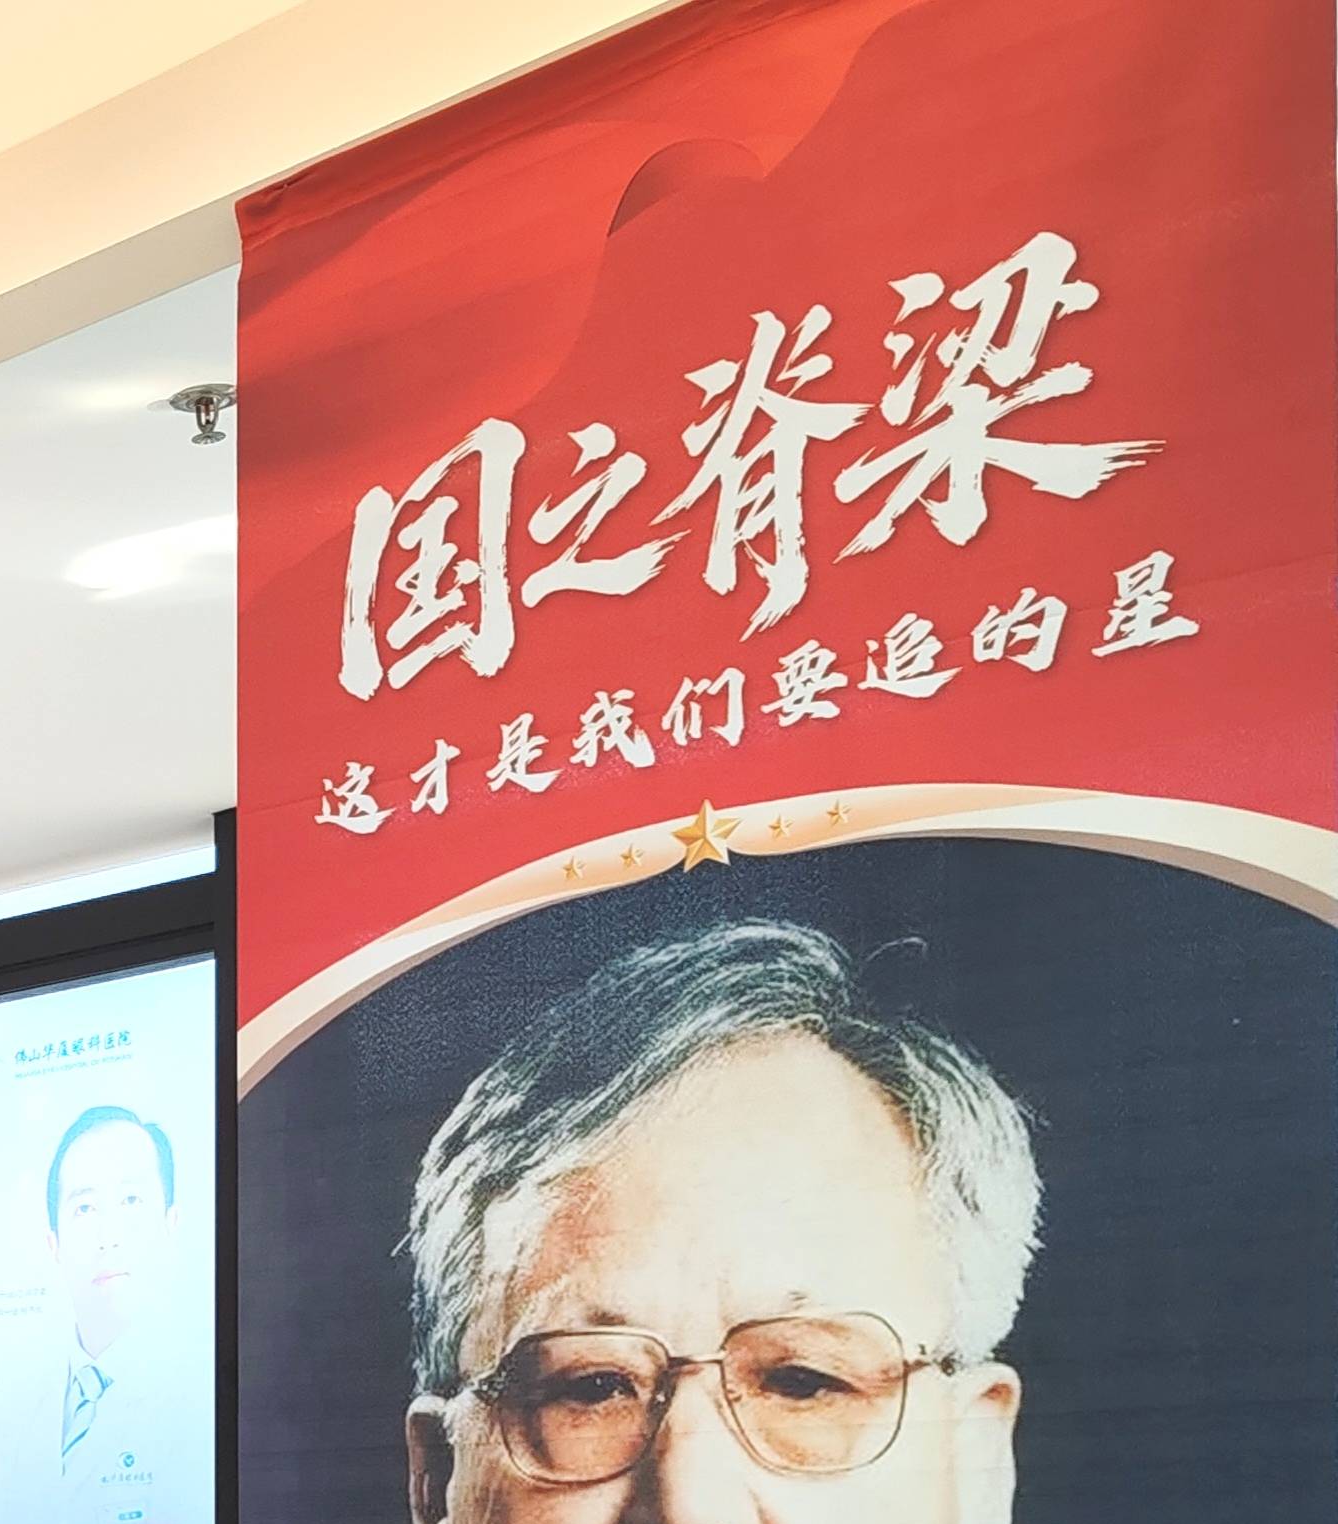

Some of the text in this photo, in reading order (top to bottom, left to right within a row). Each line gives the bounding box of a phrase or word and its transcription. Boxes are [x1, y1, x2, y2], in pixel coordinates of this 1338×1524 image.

[339, 231, 1167, 701] 国之脊梁
[314, 549, 1200, 836] 这才是我们要追的星
